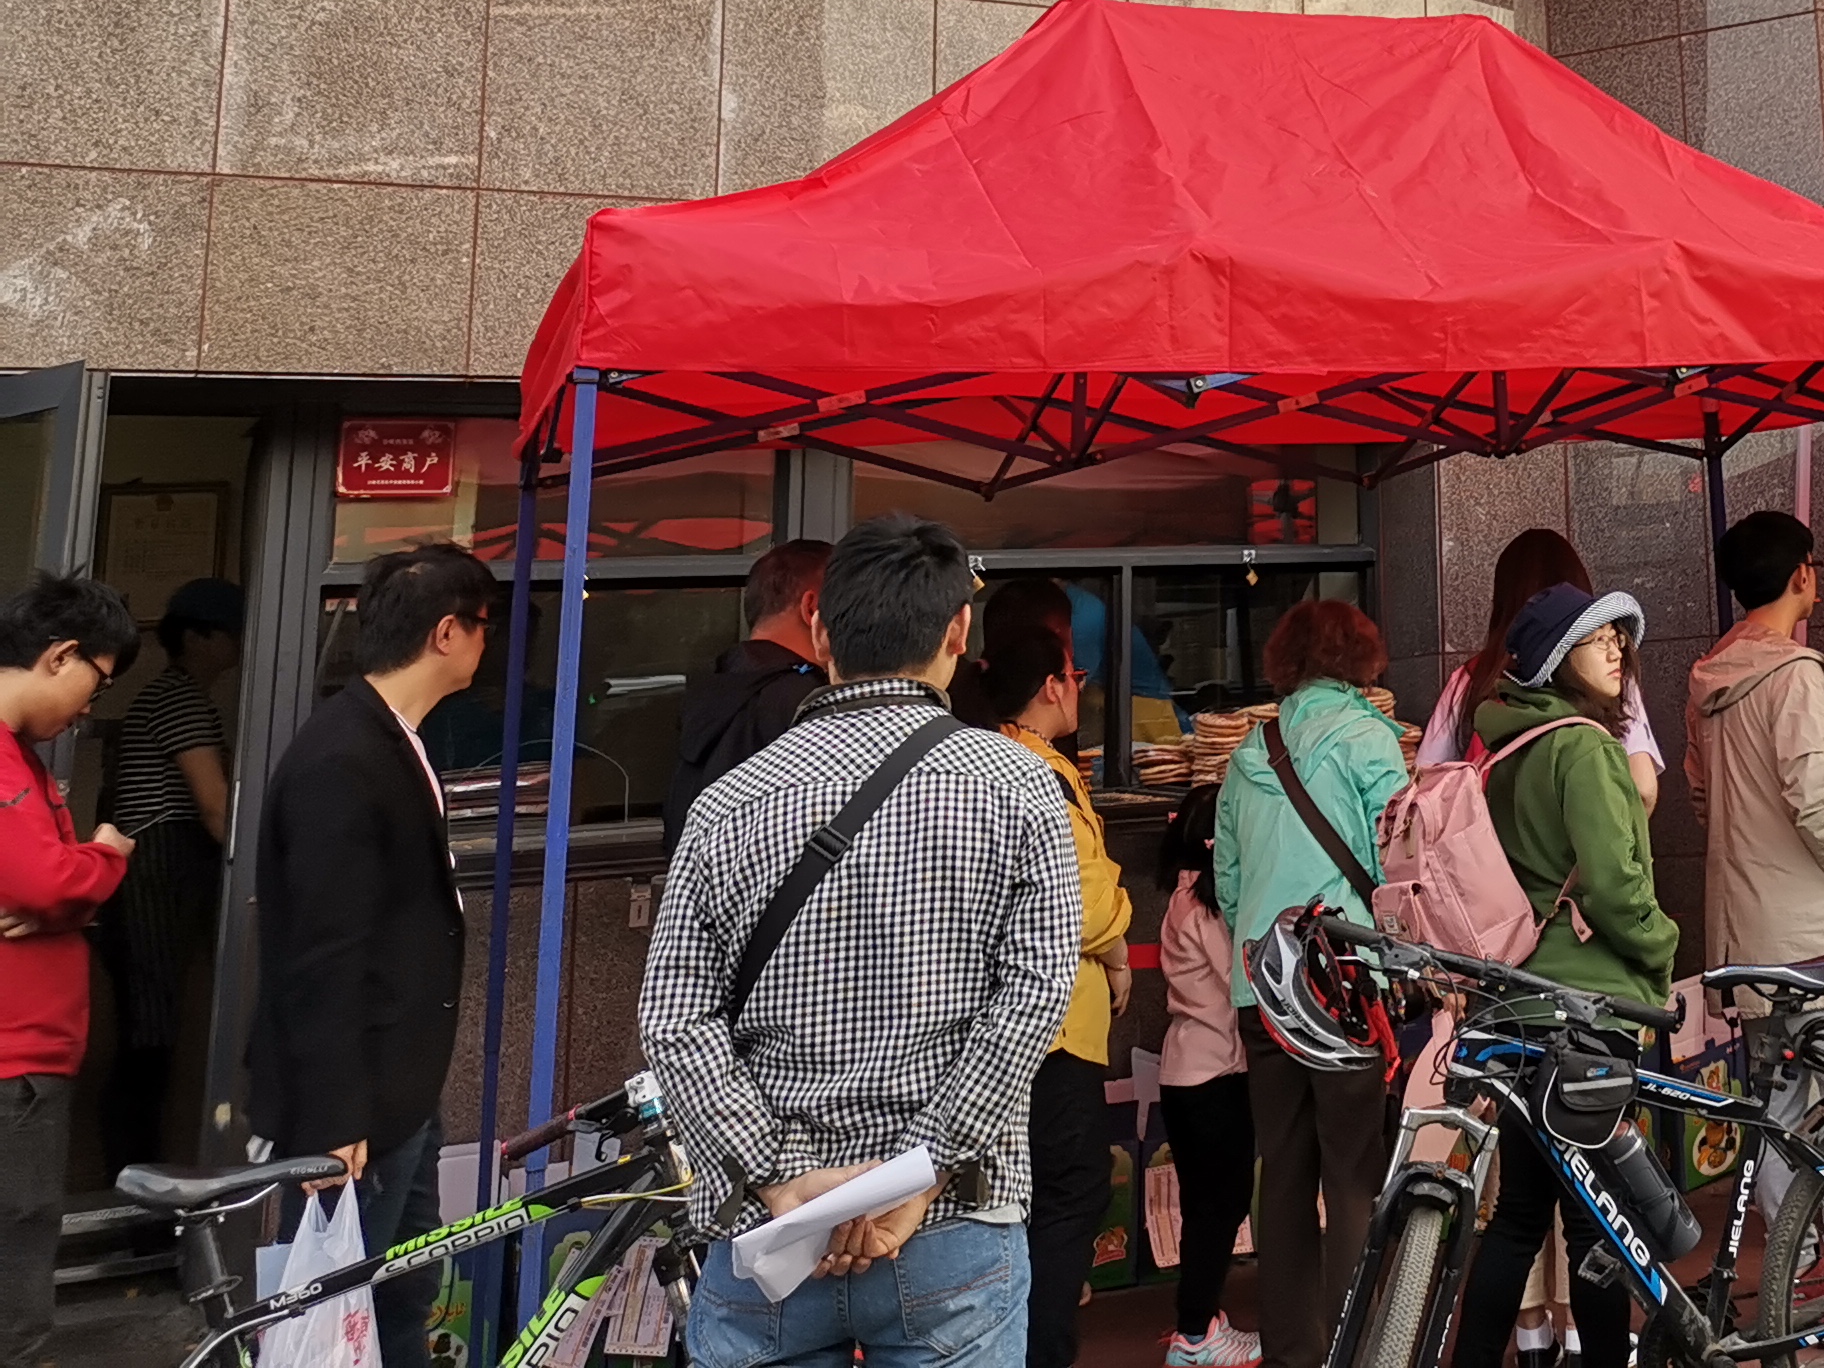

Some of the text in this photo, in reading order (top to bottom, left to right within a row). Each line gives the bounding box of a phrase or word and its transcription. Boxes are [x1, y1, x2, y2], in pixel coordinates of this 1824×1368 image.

[353, 450, 439, 474] 平安商户
[1641, 1082, 1691, 1101] JL-620
[385, 1197, 523, 1261] MISSILE
[1727, 1158, 1755, 1259] JIELANG
[384, 1213, 526, 1274] SCORPIO
